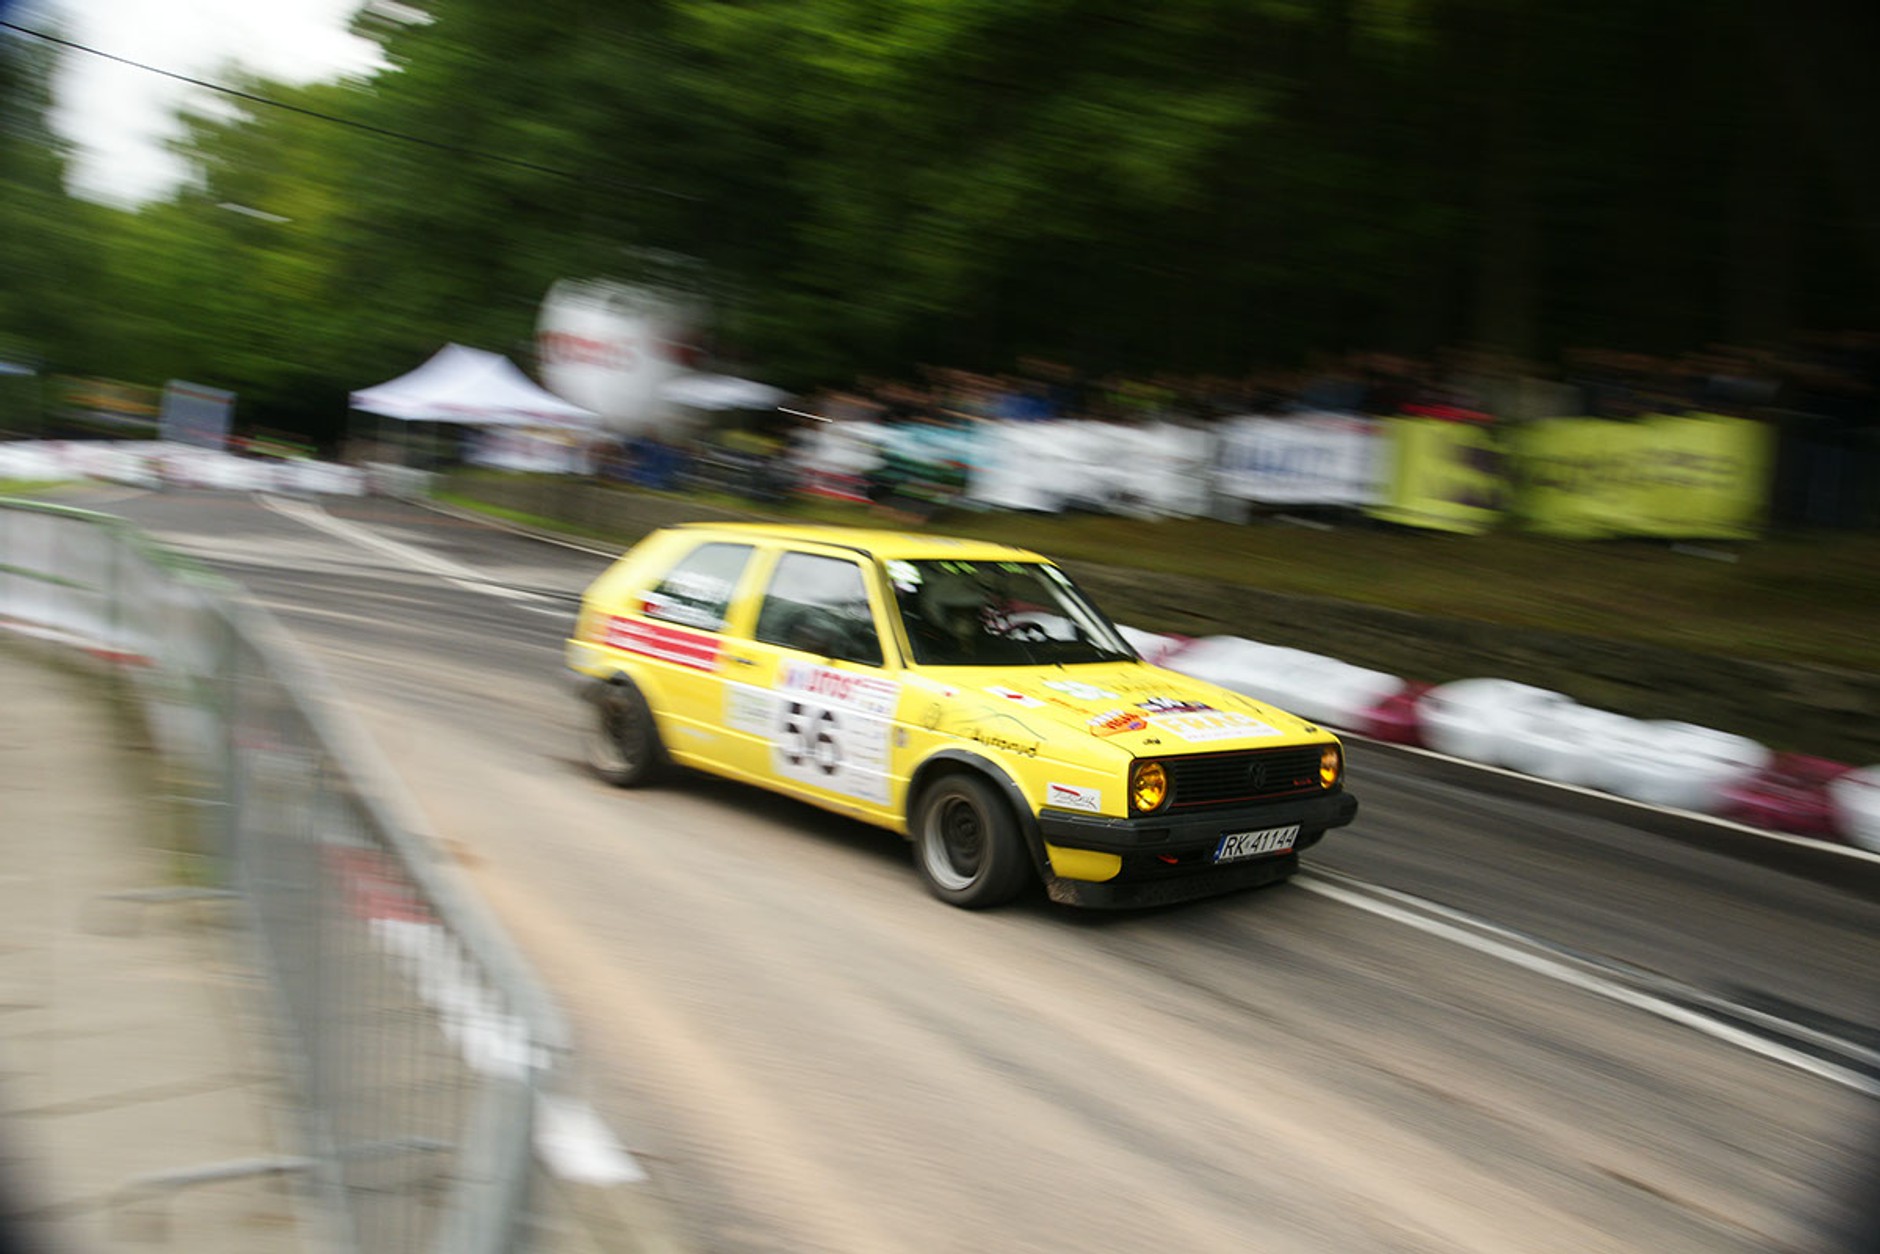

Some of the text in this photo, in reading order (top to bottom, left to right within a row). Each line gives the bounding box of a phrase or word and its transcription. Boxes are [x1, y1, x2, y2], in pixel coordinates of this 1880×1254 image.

[786, 701, 842, 775] 56
[1222, 827, 1297, 857] RK 41144
